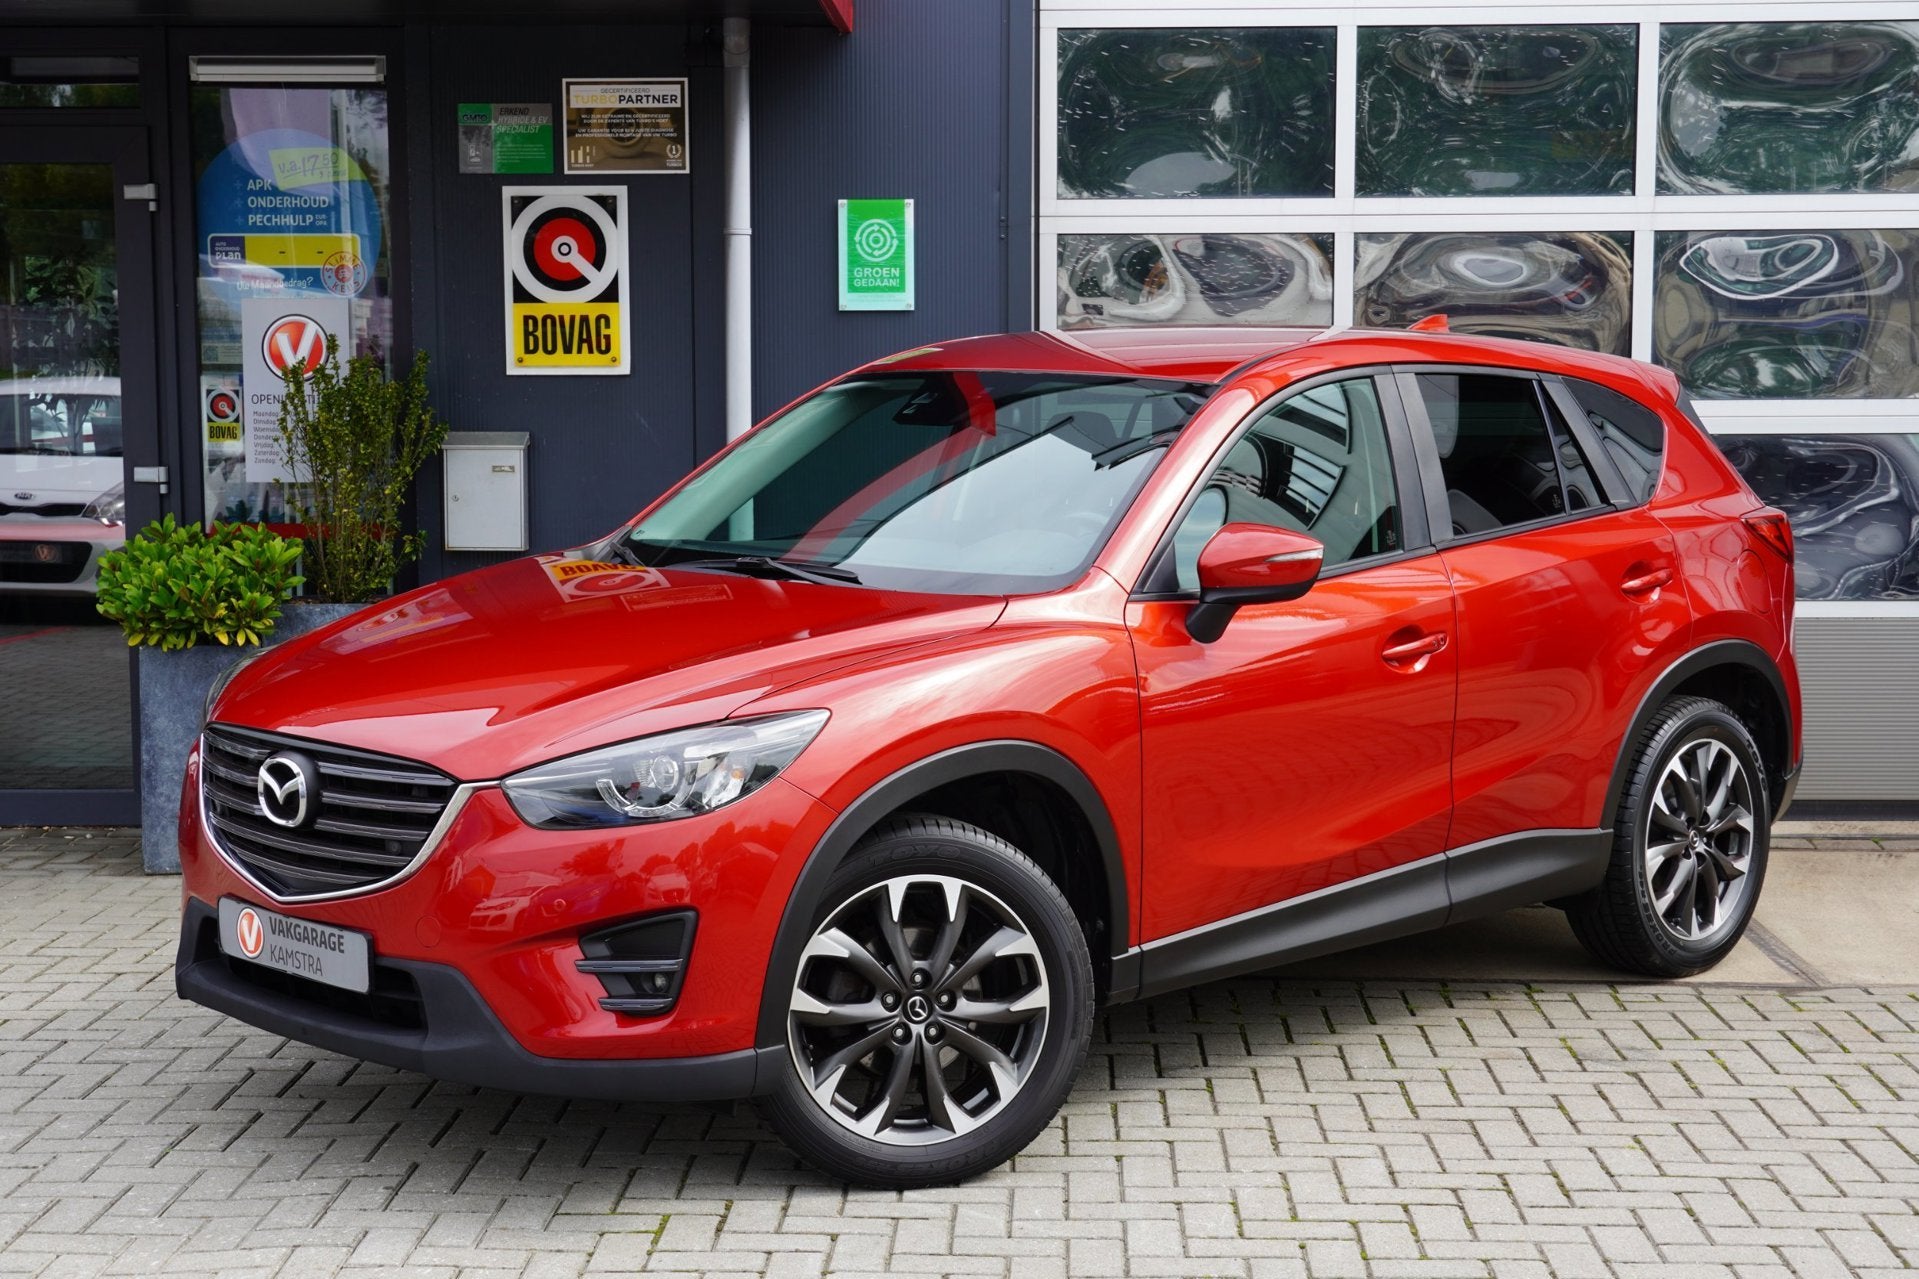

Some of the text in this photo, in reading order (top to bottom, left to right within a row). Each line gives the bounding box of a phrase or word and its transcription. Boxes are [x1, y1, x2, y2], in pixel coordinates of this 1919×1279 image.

[500, 107, 529, 116] ERKEND
[495, 125, 539, 134] SPECIALIST
[247, 179, 272, 191] APK
[247, 196, 329, 208] ONDERHOUD
[248, 214, 314, 226] PECHHULP
[854, 267, 899, 278] GROEN
[854, 278, 899, 287] GEDAAN!
[522, 313, 612, 356] BOVAG
[209, 425, 238, 440] BOVAG
[269, 916, 345, 954] VAKGARAGE
[270, 943, 324, 977] KAMSTRA
